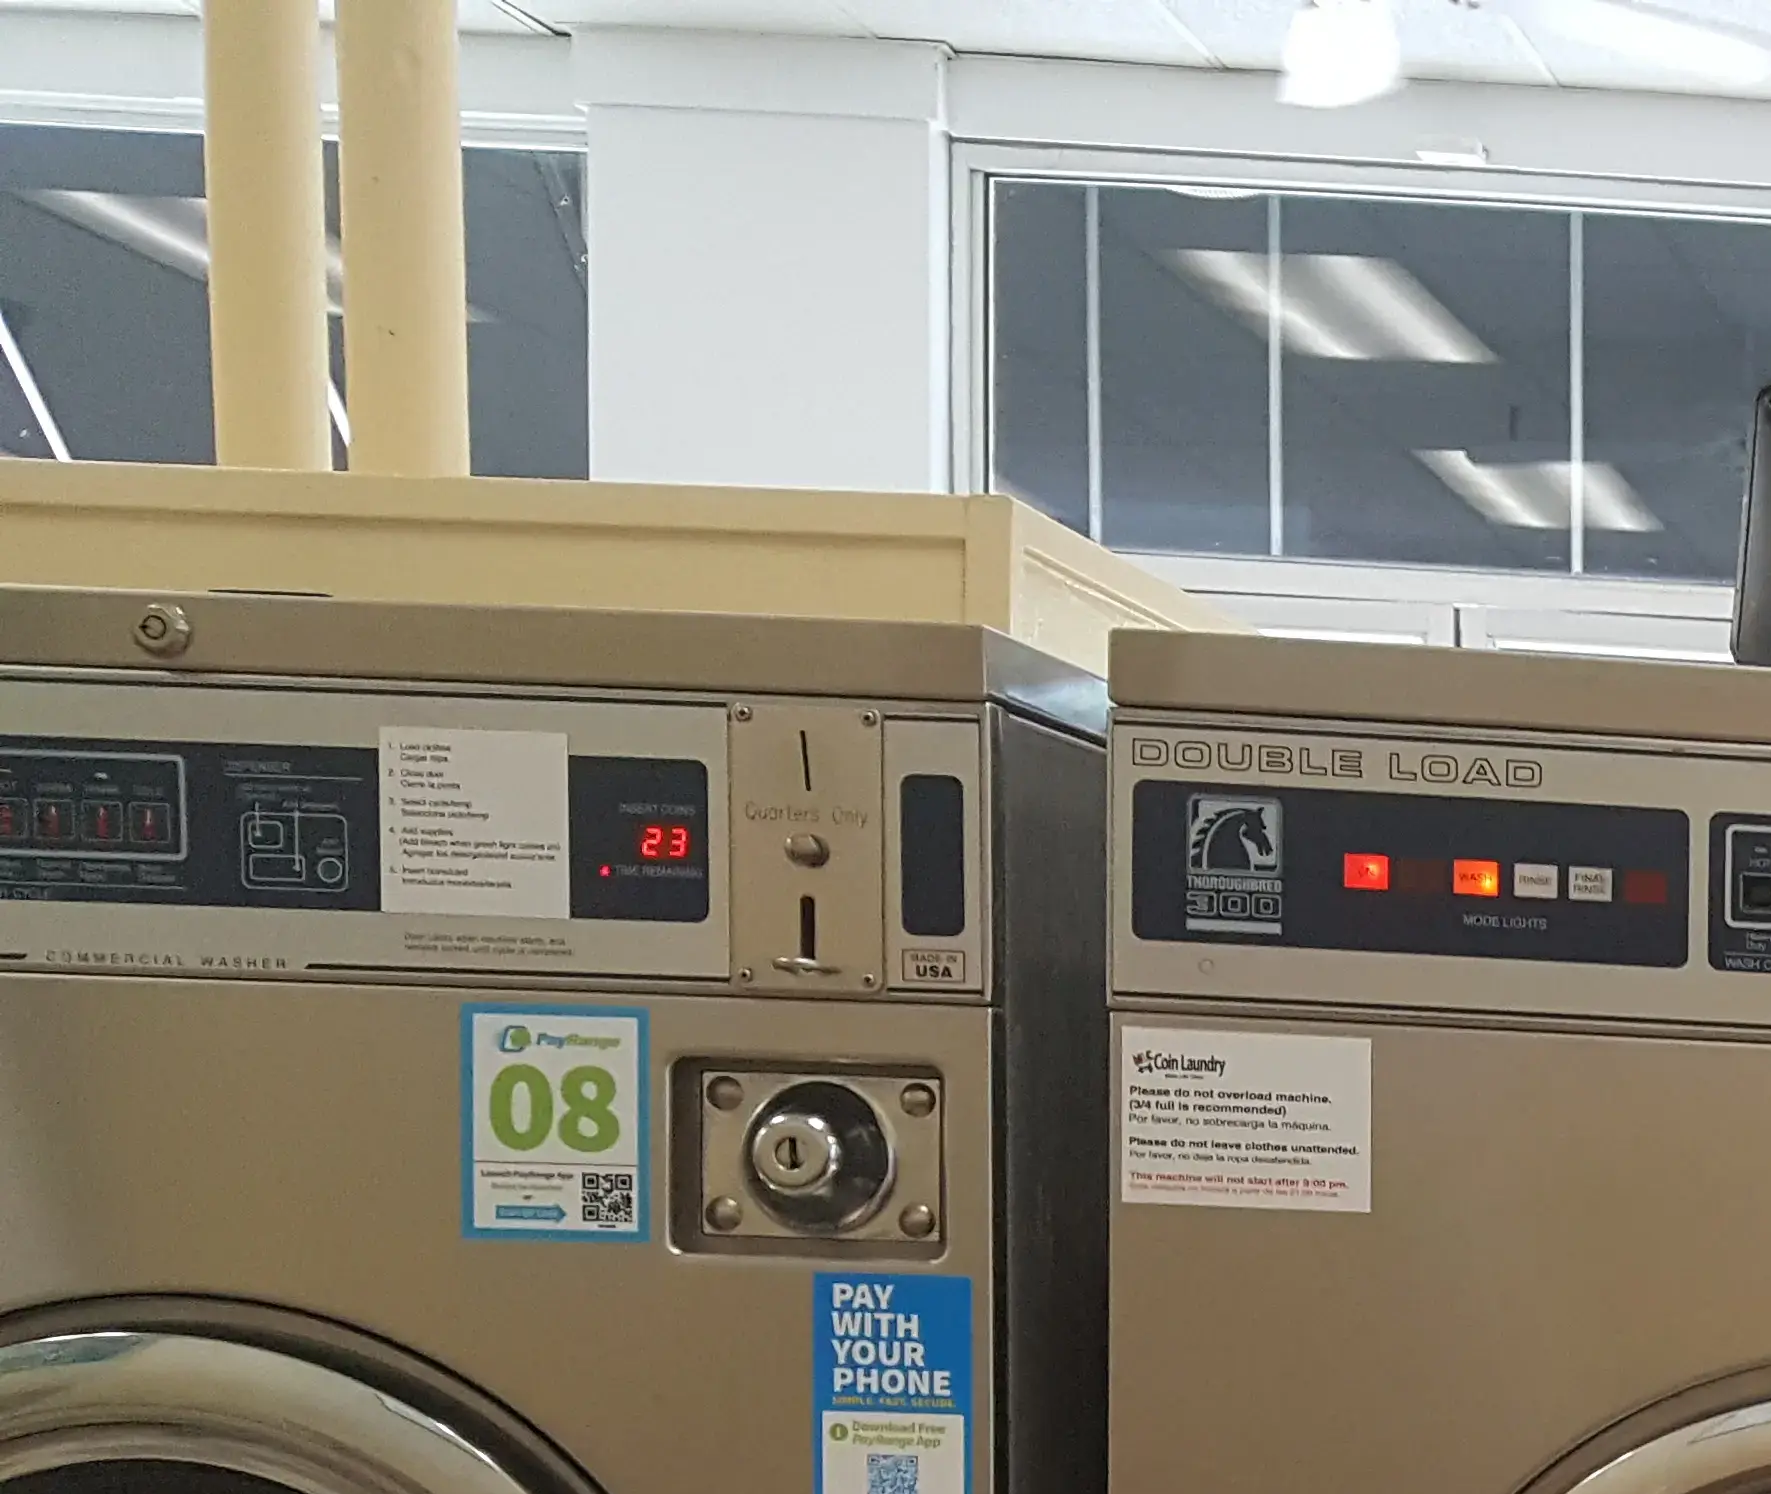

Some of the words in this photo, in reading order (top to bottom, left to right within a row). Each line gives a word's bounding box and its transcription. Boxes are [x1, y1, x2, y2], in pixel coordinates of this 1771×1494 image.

[1132, 737, 1363, 779] DOUBLE
[1389, 752, 1543, 789] LOAD
[744, 804, 820, 825] Quarters
[832, 808, 868, 829] Only
[640, 828, 688, 859] 23
[1187, 876, 1283, 893] THOROUGHBRED
[1186, 892, 1282, 919] 300
[1463, 913, 1499, 928] MODE
[1502, 915, 1548, 930] LIGHTS
[45, 951, 185, 968] COMMERCIAL
[201, 955, 288, 970] WASHER
[945, 955, 957, 964] IN
[1725, 957, 1761, 971] WASH
[915, 963, 953, 979] USA
[1154, 1054, 1178, 1070] Coin
[1181, 1054, 1226, 1077] Laundry
[1130, 1085, 1170, 1097] Please
[1174, 1087, 1190, 1097] do
[1194, 1088, 1214, 1099] not
[1218, 1090, 1272, 1101] overload
[1276, 1091, 1332, 1104] machine.
[489, 1064, 621, 1152] 08
[1129, 1101, 1151, 1112] (3/4
[1155, 1100, 1175, 1111] full
[1178, 1101, 1189, 1111] is
[1193, 1103, 1287, 1117] recommended)
[1129, 1113, 1148, 1124] Por
[1269, 1119, 1278, 1129] la
[1129, 1136, 1167, 1147] Please
[1171, 1137, 1185, 1148] do
[1189, 1138, 1208, 1149] not
[1211, 1139, 1241, 1150] leave
[1245, 1141, 1288, 1152] clothes
[1291, 1143, 1359, 1155] unattended.
[832, 1282, 894, 1310] PAY
[831, 1311, 919, 1339] WITH
[831, 1339, 925, 1367] YOUR
[833, 1368, 951, 1396] PHONE
[853, 1421, 915, 1434] Download
[919, 1424, 946, 1434] Free
[853, 1434, 913, 1449] PayRange
[916, 1436, 941, 1449] App
